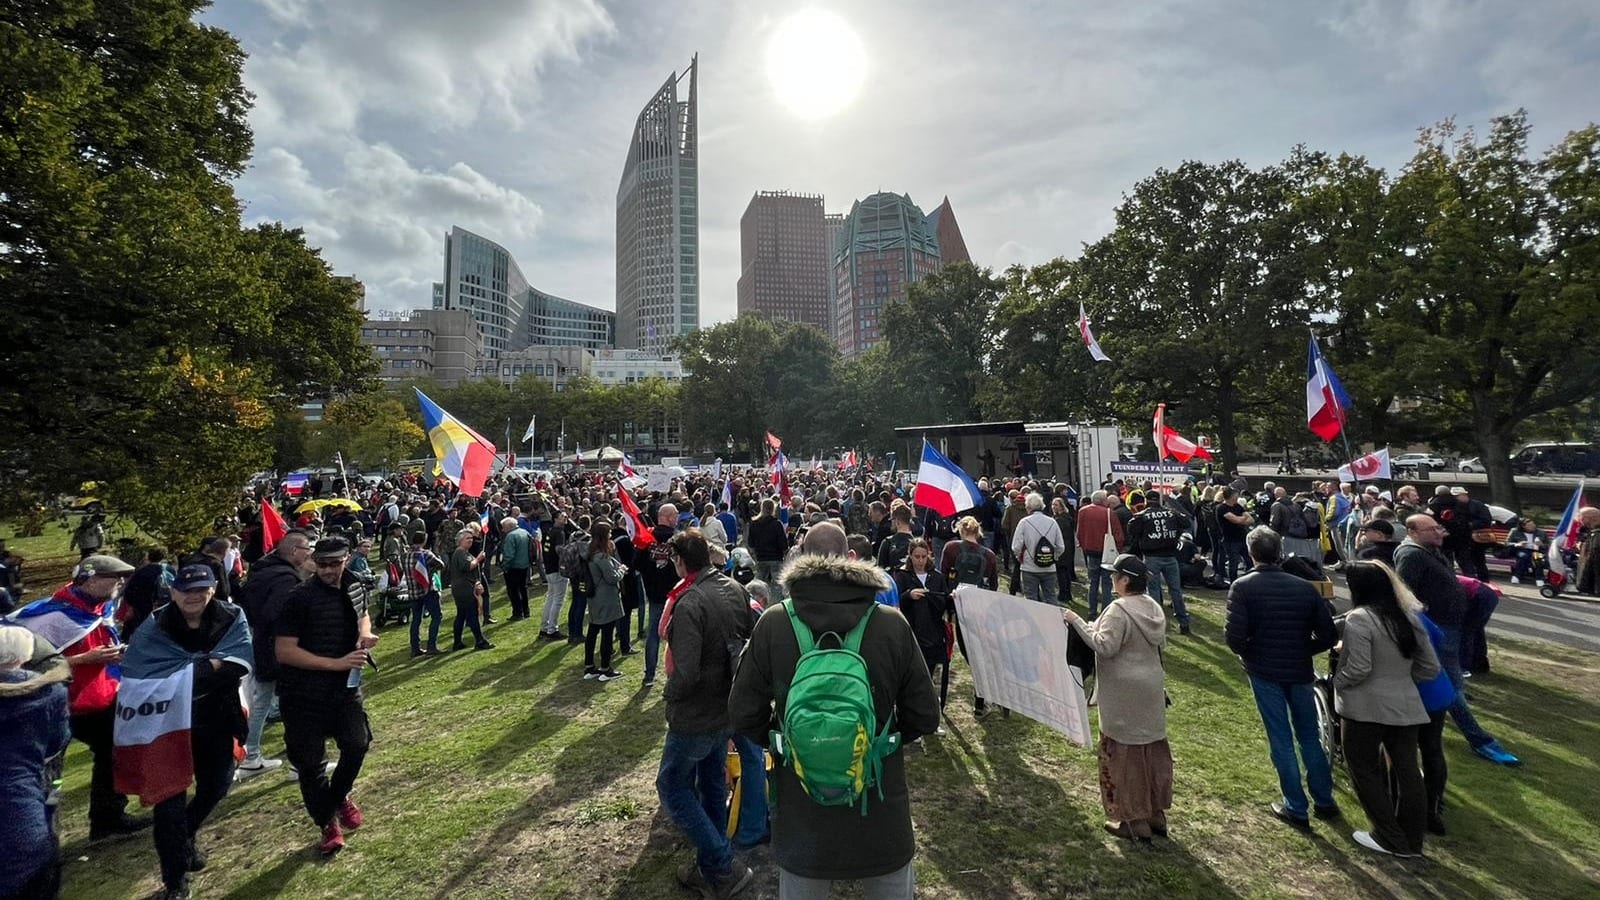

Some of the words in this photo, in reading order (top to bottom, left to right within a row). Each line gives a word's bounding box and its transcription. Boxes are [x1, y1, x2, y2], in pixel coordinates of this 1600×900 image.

[1145, 511, 1173, 519] TROTS
[1155, 525, 1168, 533] DE
[1148, 530, 1177, 539] WAPPIE
